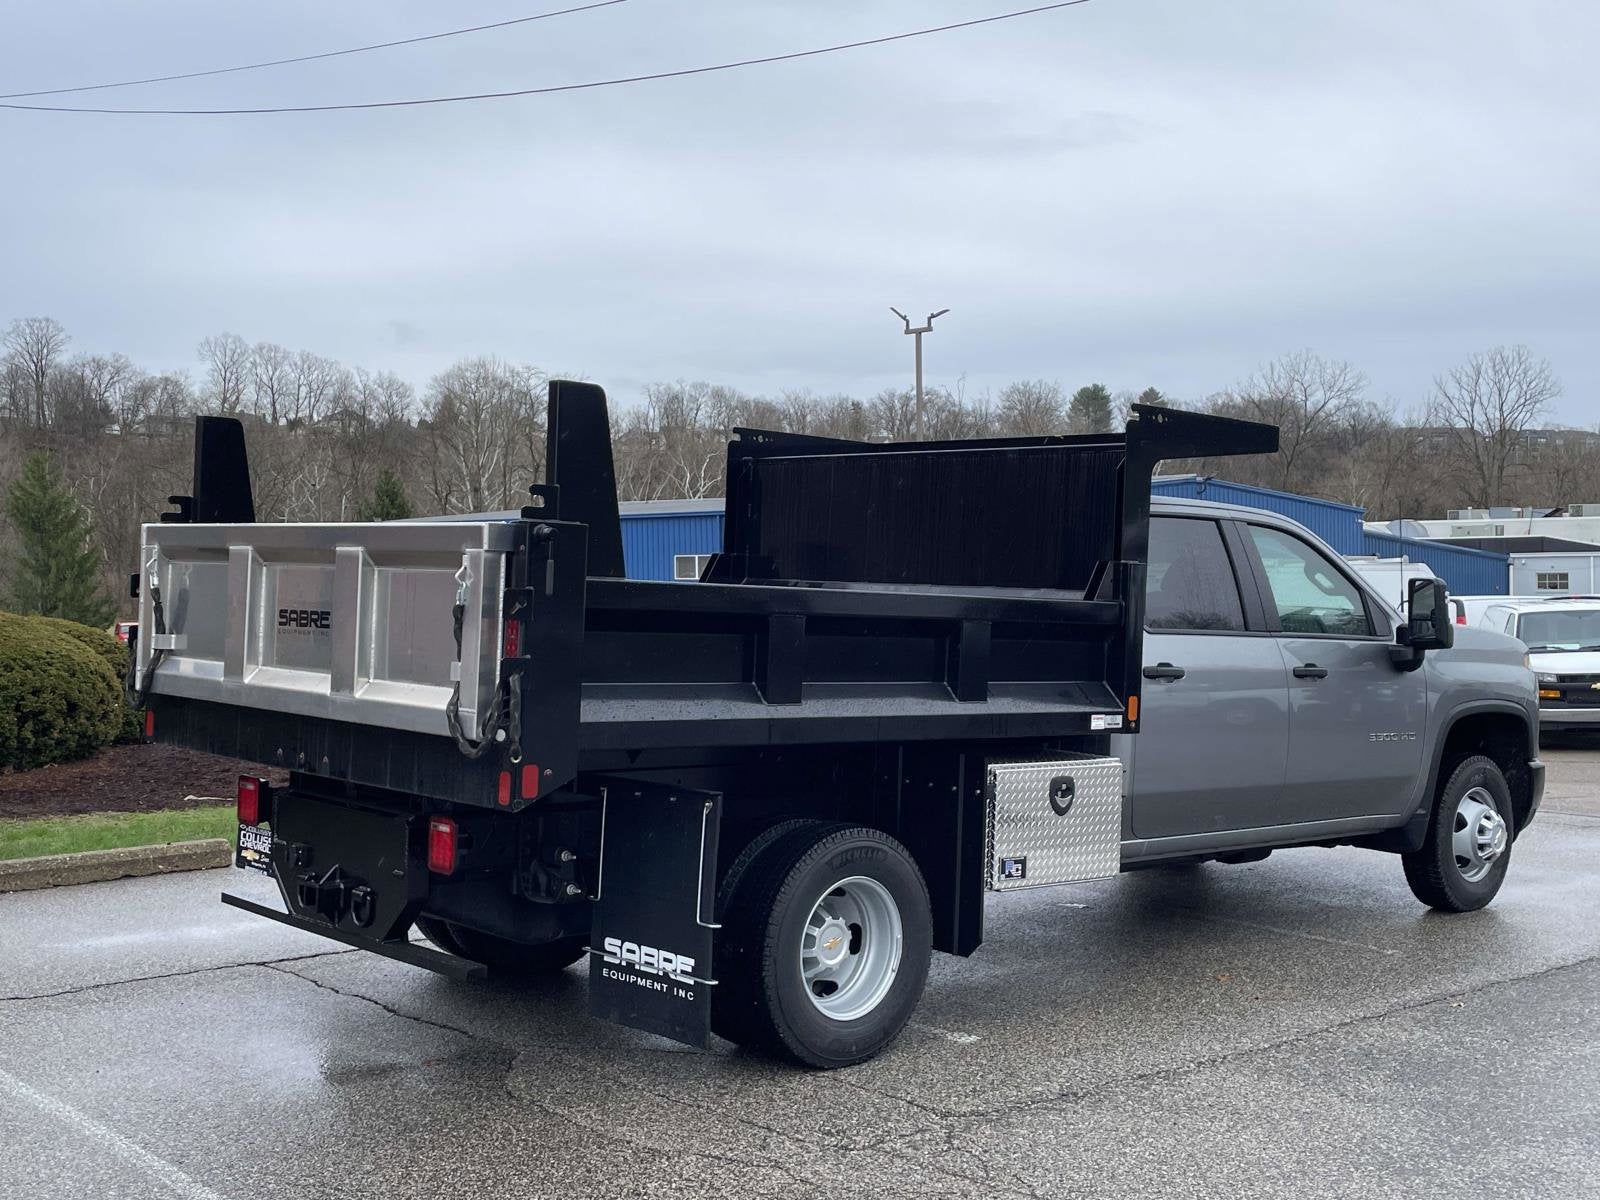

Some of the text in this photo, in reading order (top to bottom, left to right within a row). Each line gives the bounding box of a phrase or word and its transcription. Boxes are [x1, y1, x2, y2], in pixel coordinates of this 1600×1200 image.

[278, 608, 331, 628] SABRE
[240, 840, 271, 854] CHEVROL
[603, 936, 695, 985] SABRE
[602, 968, 694, 1001] EQUIPMENT INC
